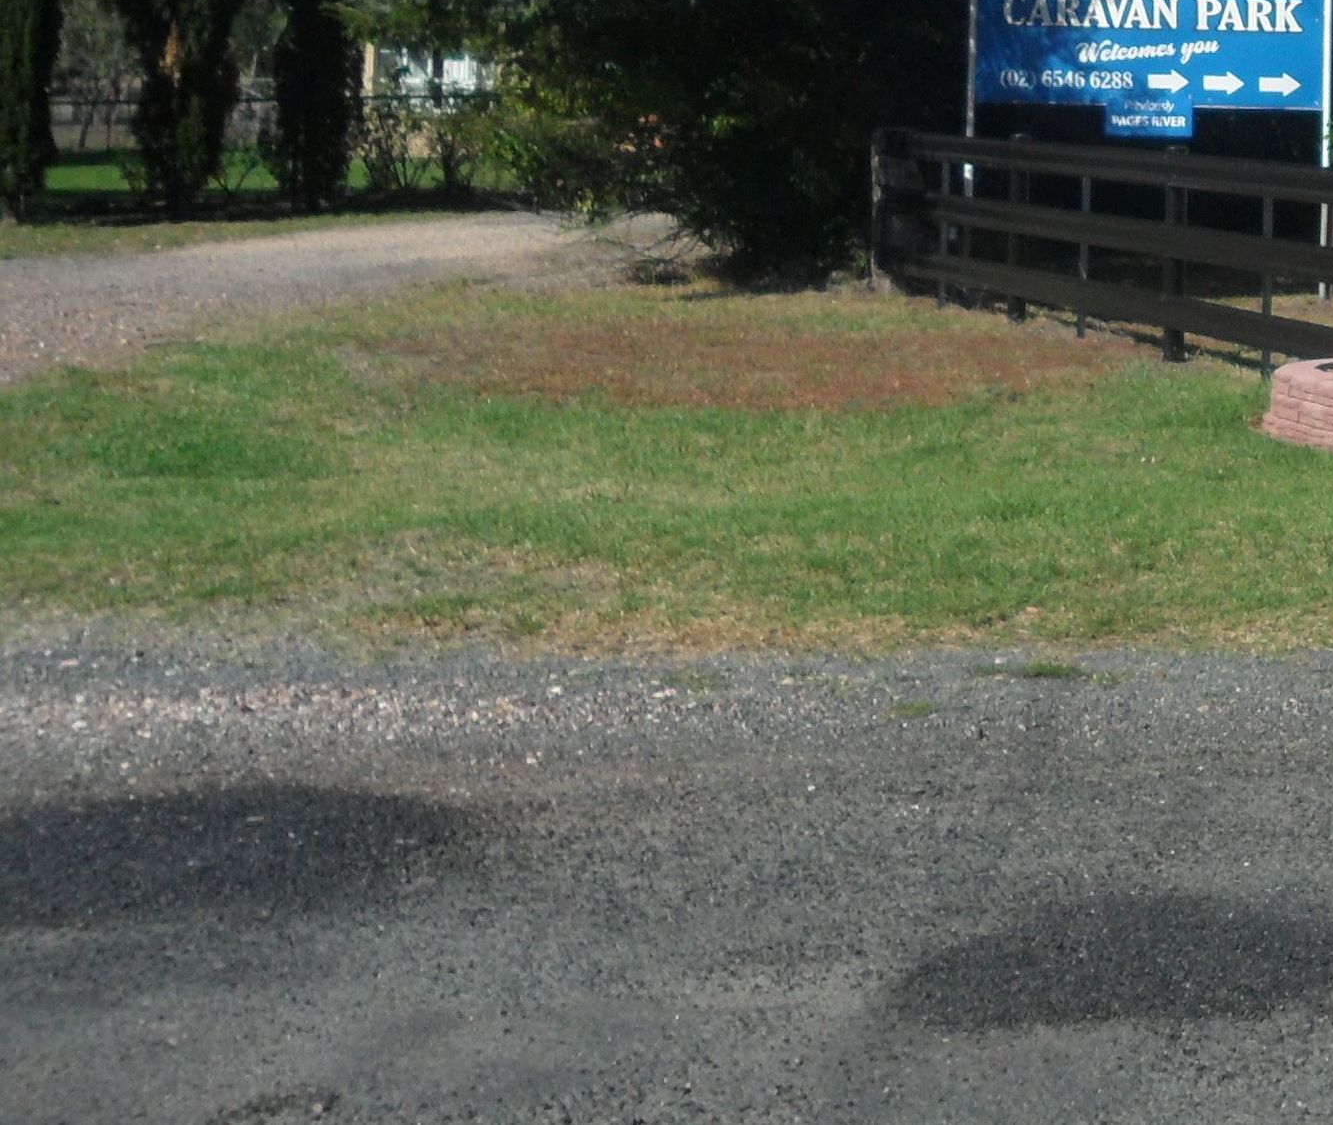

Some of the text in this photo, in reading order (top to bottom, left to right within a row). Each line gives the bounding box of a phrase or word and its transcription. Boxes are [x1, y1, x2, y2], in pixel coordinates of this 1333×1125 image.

[1076, 39, 1219, 65] Welcomes you
[1000, 68, 1133, 89] (02) 6546 6288
[1152, 116, 1186, 127] RIVER
